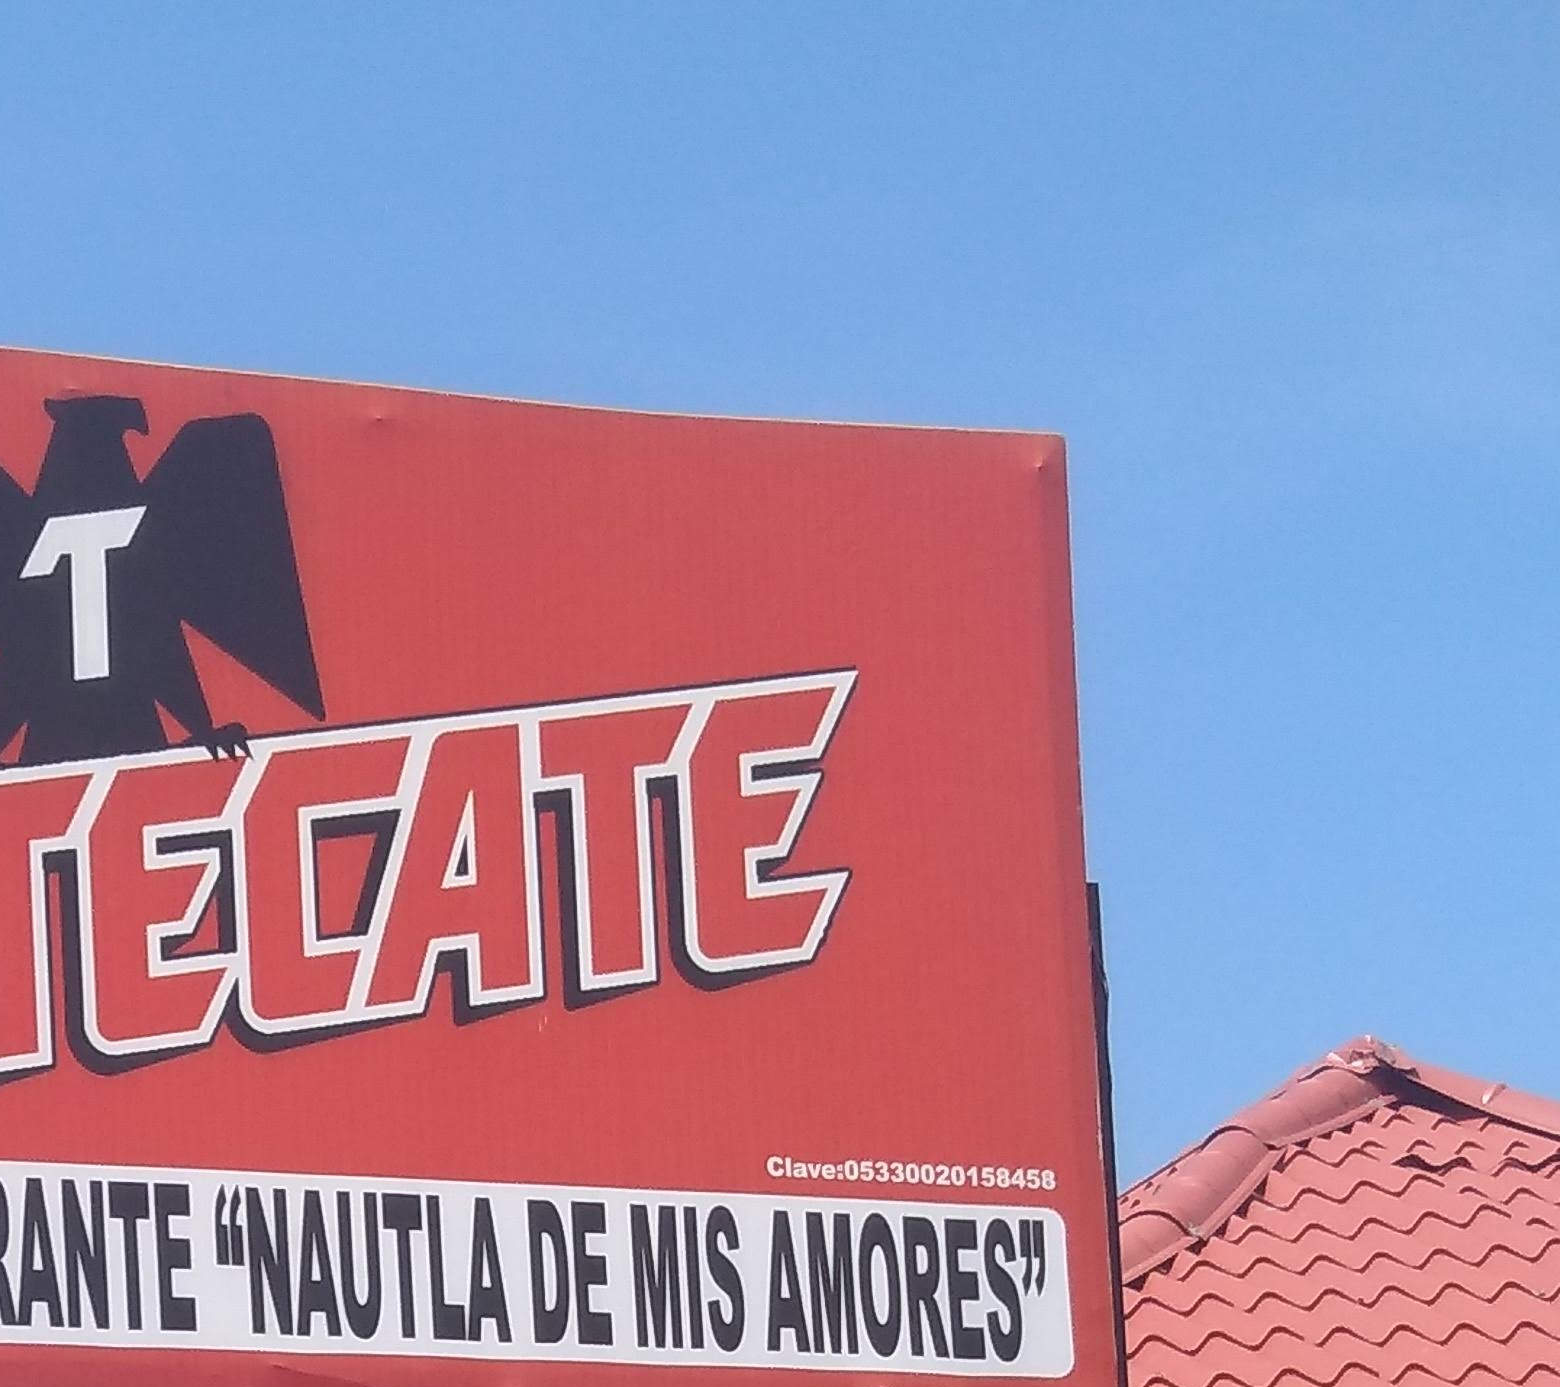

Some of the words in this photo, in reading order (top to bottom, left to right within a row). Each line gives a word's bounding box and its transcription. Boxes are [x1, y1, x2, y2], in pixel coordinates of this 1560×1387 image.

[20, 506, 147, 682] T
[766, 1156, 1056, 1190] Clave:05330020158458
[215, 1183, 512, 1344] “NAUTLA
[528, 1198, 614, 1347] DE
[630, 1203, 745, 1353] MIS
[767, 1209, 1047, 1363] AMORES”
